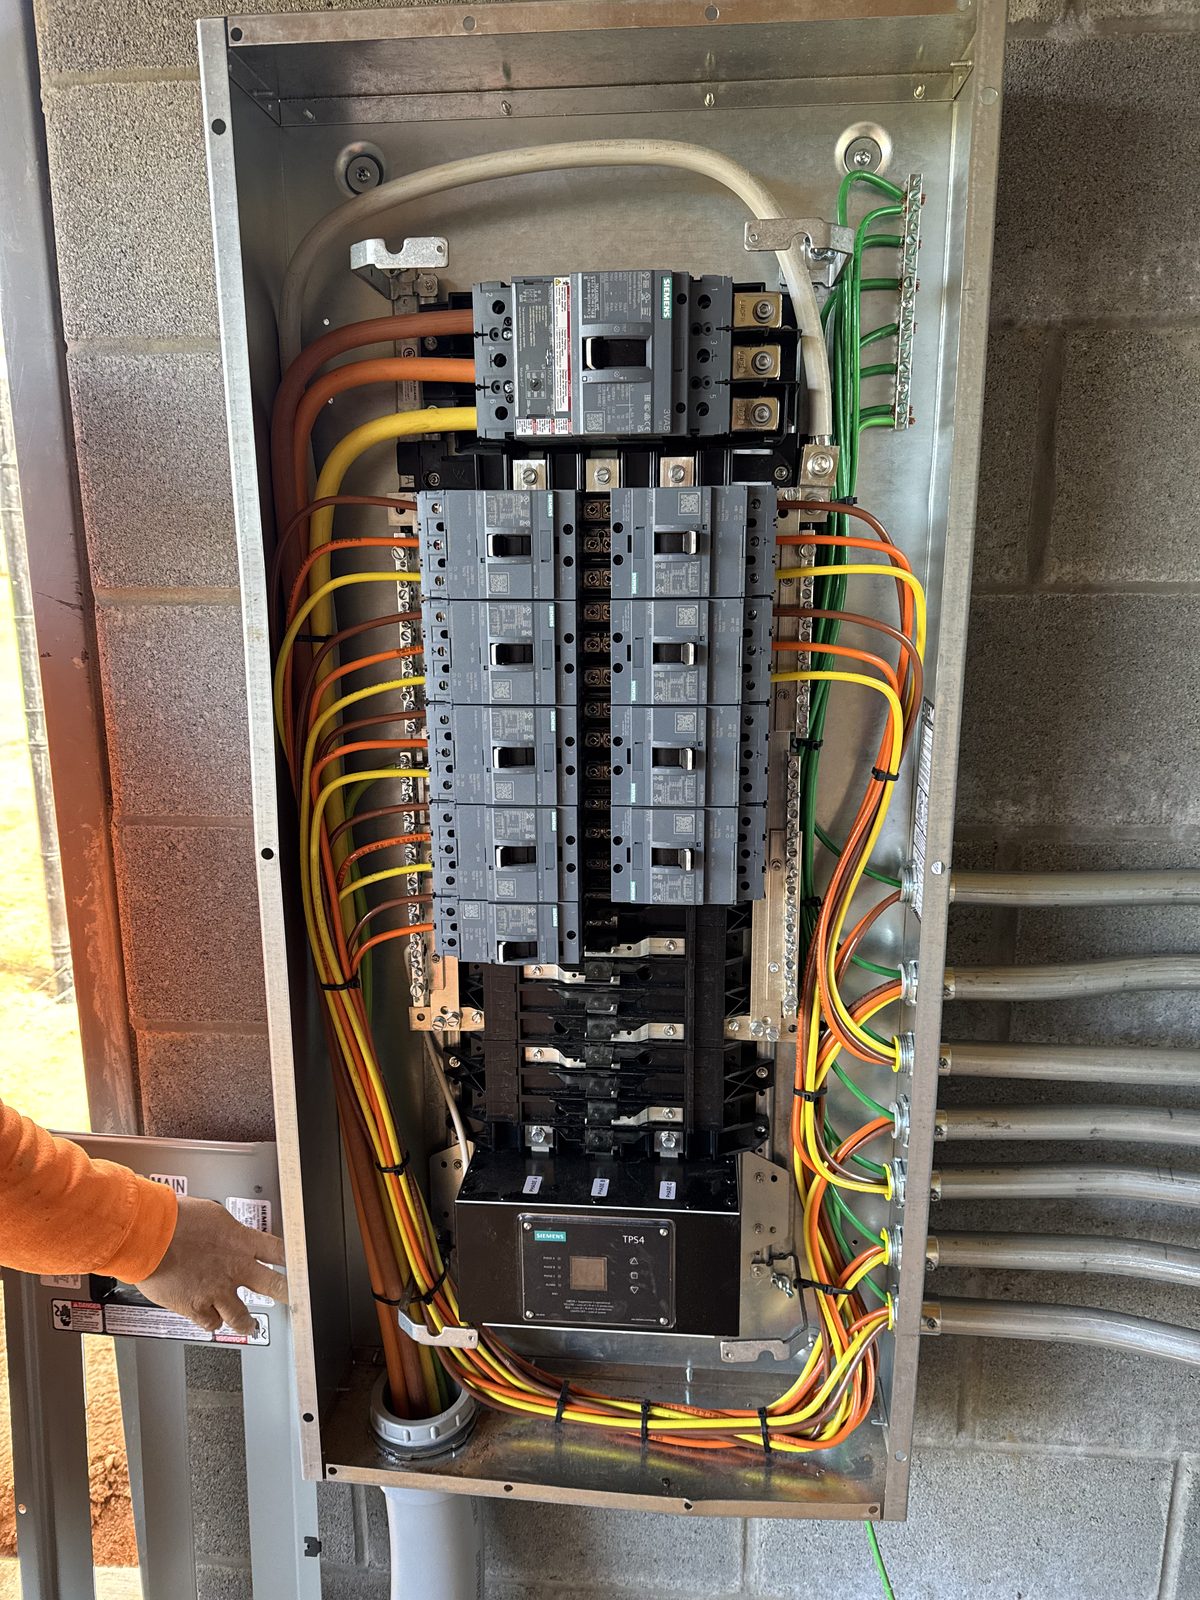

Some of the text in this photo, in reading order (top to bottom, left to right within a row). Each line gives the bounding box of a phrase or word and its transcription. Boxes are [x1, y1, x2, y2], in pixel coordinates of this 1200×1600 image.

[662, 278, 671, 318] SIEMENS
[529, 1180, 537, 1192] PHASE
[536, 1232, 645, 1244] SIEMENS TPS4
